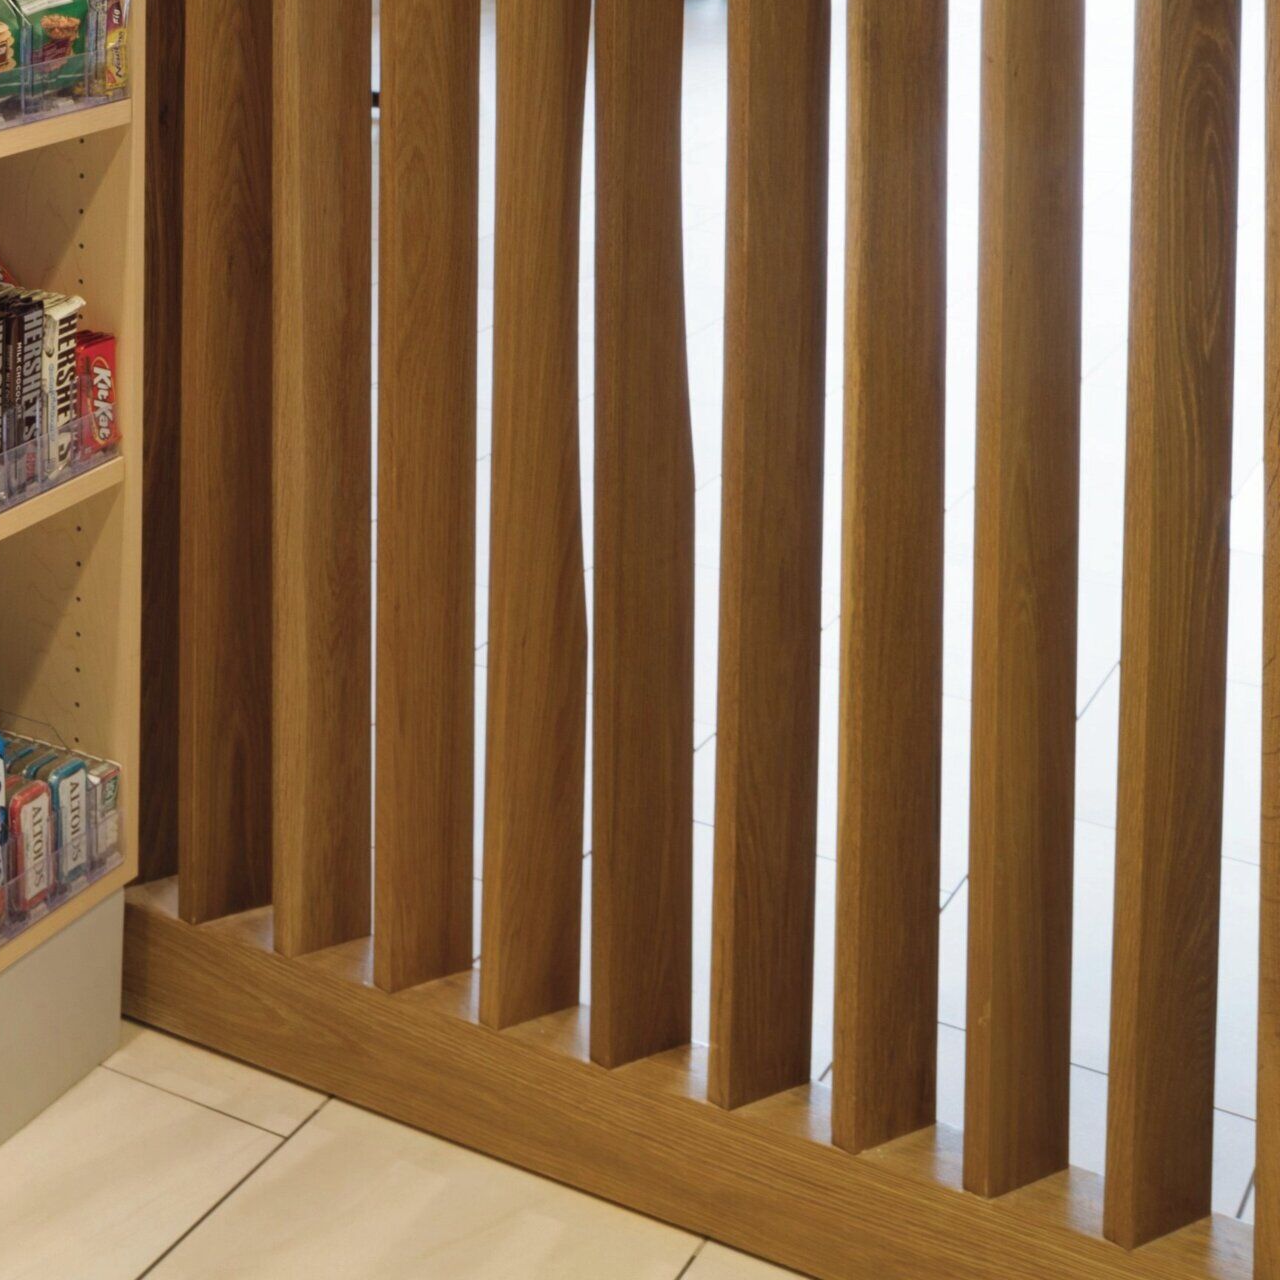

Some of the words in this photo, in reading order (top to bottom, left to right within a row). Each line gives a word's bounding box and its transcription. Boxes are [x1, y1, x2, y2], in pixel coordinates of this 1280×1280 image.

[23, 310, 42, 442] HERSHEY'S
[32, 806, 44, 887] ALTOIDS
[69, 781, 82, 862] ALTOIDS
